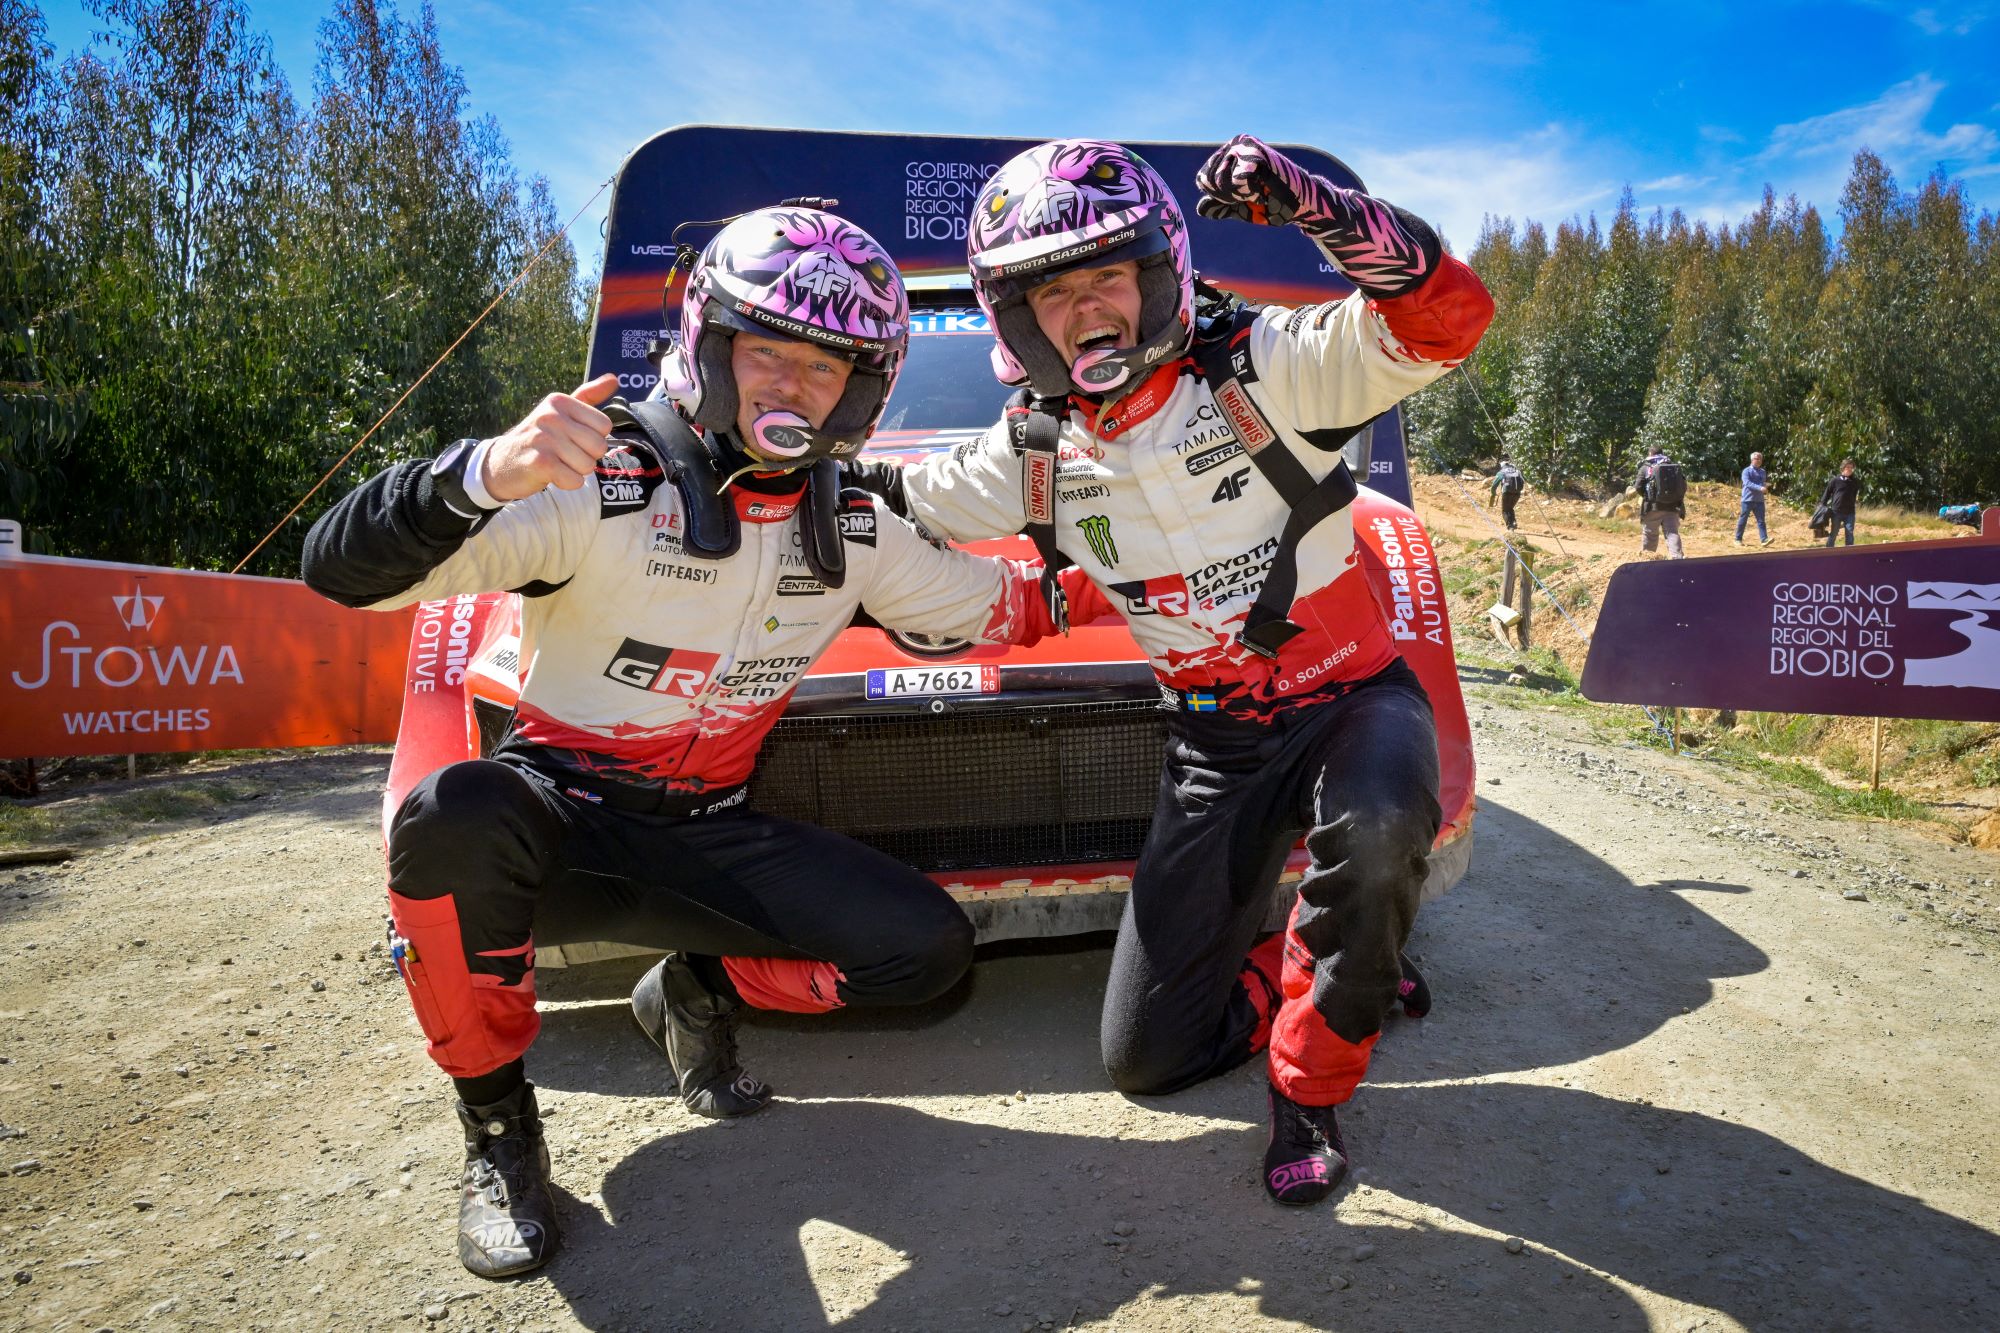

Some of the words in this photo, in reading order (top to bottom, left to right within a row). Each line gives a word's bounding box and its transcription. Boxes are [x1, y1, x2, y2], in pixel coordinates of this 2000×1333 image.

[906, 180, 981, 198] REGION
[905, 199, 965, 214] REGION
[905, 215, 968, 240] BIOB
[1004, 257, 1047, 275] TOYOTA
[1050, 242, 1097, 262] GAZOO
[1098, 228, 1136, 249] Racing
[621, 329, 658, 337] GOBIERNO
[754, 309, 803, 333] TOYOTA
[807, 328, 854, 346] GAZOO
[854, 338, 886, 351] Racing
[621, 349, 647, 358] BIOBI
[1144, 340, 1174, 364] Oliver
[617, 373, 658, 389] COP
[1223, 390, 1264, 443] SIMPSON
[1056, 446, 1105, 461] ENSO
[1172, 425, 1230, 456] TAMAD
[1056, 464, 1095, 474] anasonic
[1186, 445, 1246, 473] CENTRA
[1370, 461, 1393, 474] SEI
[1031, 460, 1046, 517] SIMPSON
[1055, 474, 1098, 483] UTOMOTIVE
[1211, 466, 1251, 504] 4F
[601, 484, 644, 501] OMP
[1185, 536, 1279, 588] TOYOTA
[1370, 517, 1417, 641] Panasonic
[1396, 516, 1444, 646] AUTOMOTIVE
[1199, 579, 1264, 611] Racin
[1772, 582, 1899, 605] GOBIERNO
[1772, 605, 1897, 628] REGIONAL
[414, 599, 448, 694] MOTIVE
[445, 593, 478, 686] asonic
[1771, 627, 1847, 647] REGION
[1858, 629, 1894, 648] DEL
[12, 620, 245, 690] STOWA
[1278, 679, 1294, 692] O.
[1296, 640, 1358, 684] SOLBERG
[1770, 647, 1895, 679] BIOBIO
[609, 657, 706, 698] GR
[871, 687, 883, 695] FIN
[892, 671, 974, 693] A-7662
[983, 666, 995, 677] 11
[983, 680, 995, 692] 26
[63, 708, 211, 735] WATCHES
[1270, 1161, 1327, 1190] OMP
